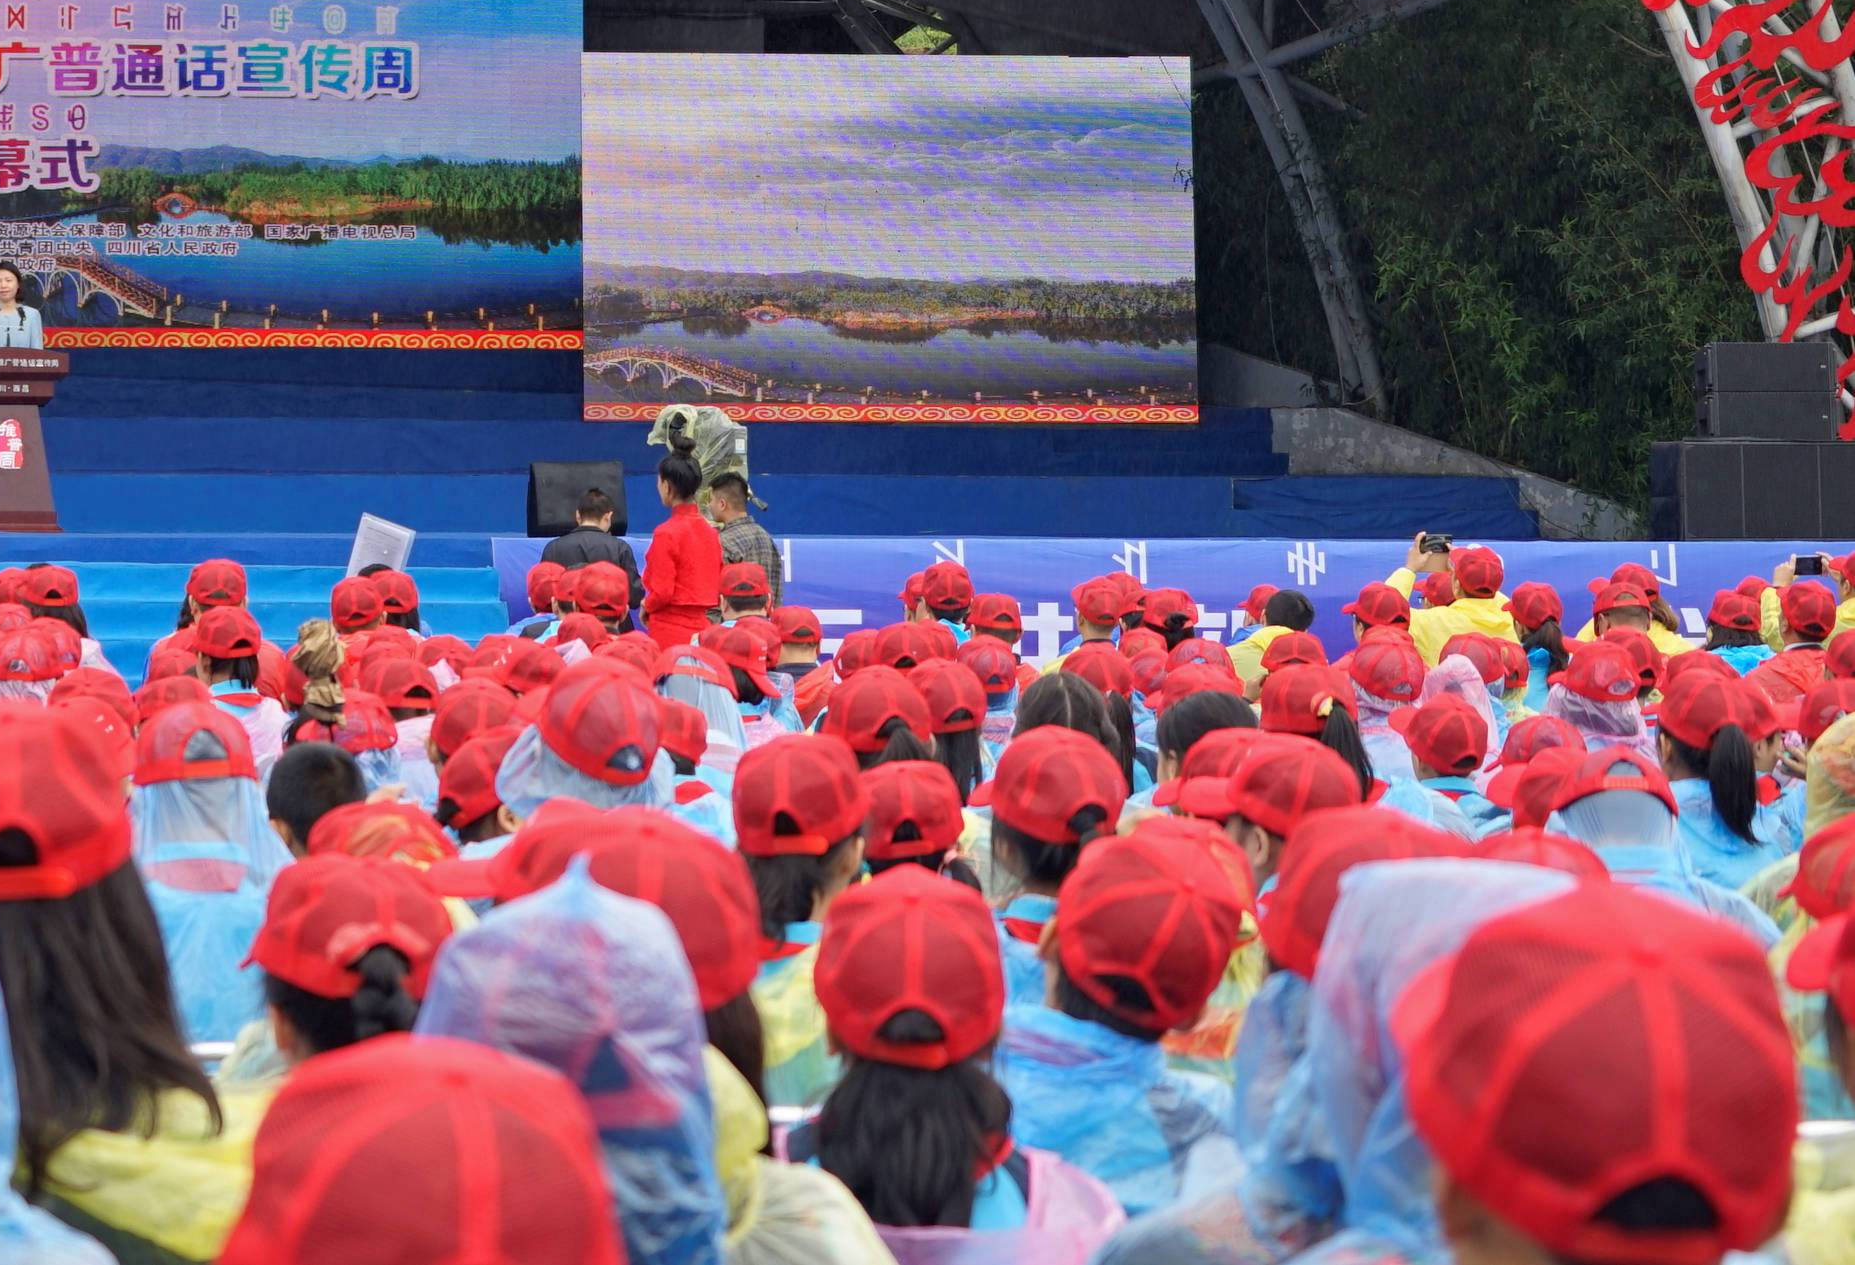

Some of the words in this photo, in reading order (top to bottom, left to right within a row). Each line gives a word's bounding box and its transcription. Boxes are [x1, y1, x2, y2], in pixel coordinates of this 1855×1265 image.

[138, 223, 253, 239] 文化和旅游部
[265, 224, 416, 240] 国家广播电视总局
[0, 240, 93, 255] 共青团中央
[107, 240, 239, 255] 四川省人民政府
